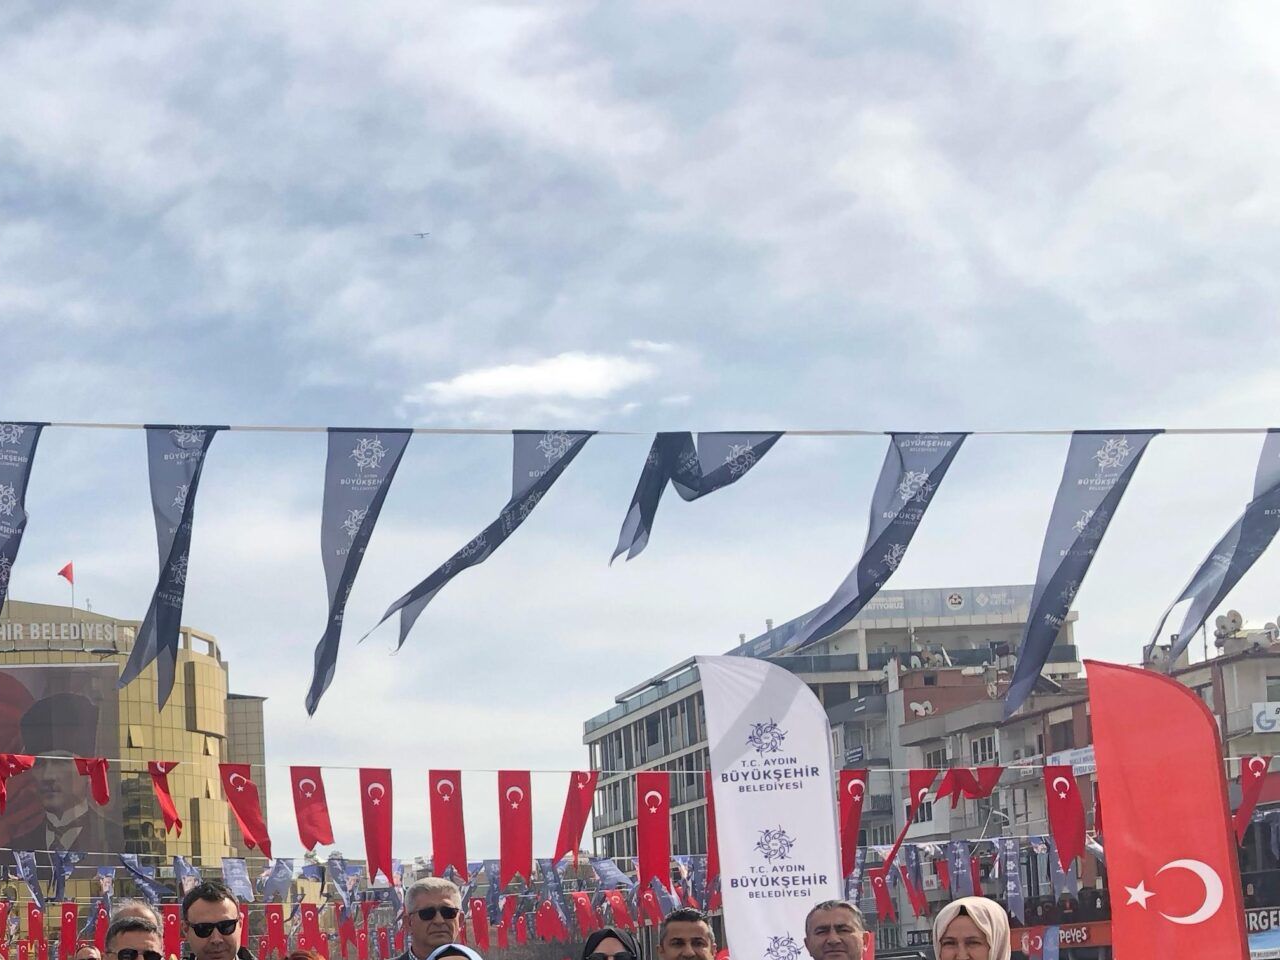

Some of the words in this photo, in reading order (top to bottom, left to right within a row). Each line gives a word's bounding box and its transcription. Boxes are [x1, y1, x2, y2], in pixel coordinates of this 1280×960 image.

[29, 621, 117, 641] BELEDİYESİ
[741, 759, 760, 767] T.C.
[763, 757, 797, 766] AYDIN
[721, 765, 820, 783] BÜYÜKŞEHİR
[739, 781, 803, 793] BELEDİYESİ
[771, 864, 805, 873] AYDIN
[730, 874, 828, 889] BÜYÜKŞEHİR
[748, 888, 811, 899] BELEDİYESİ
